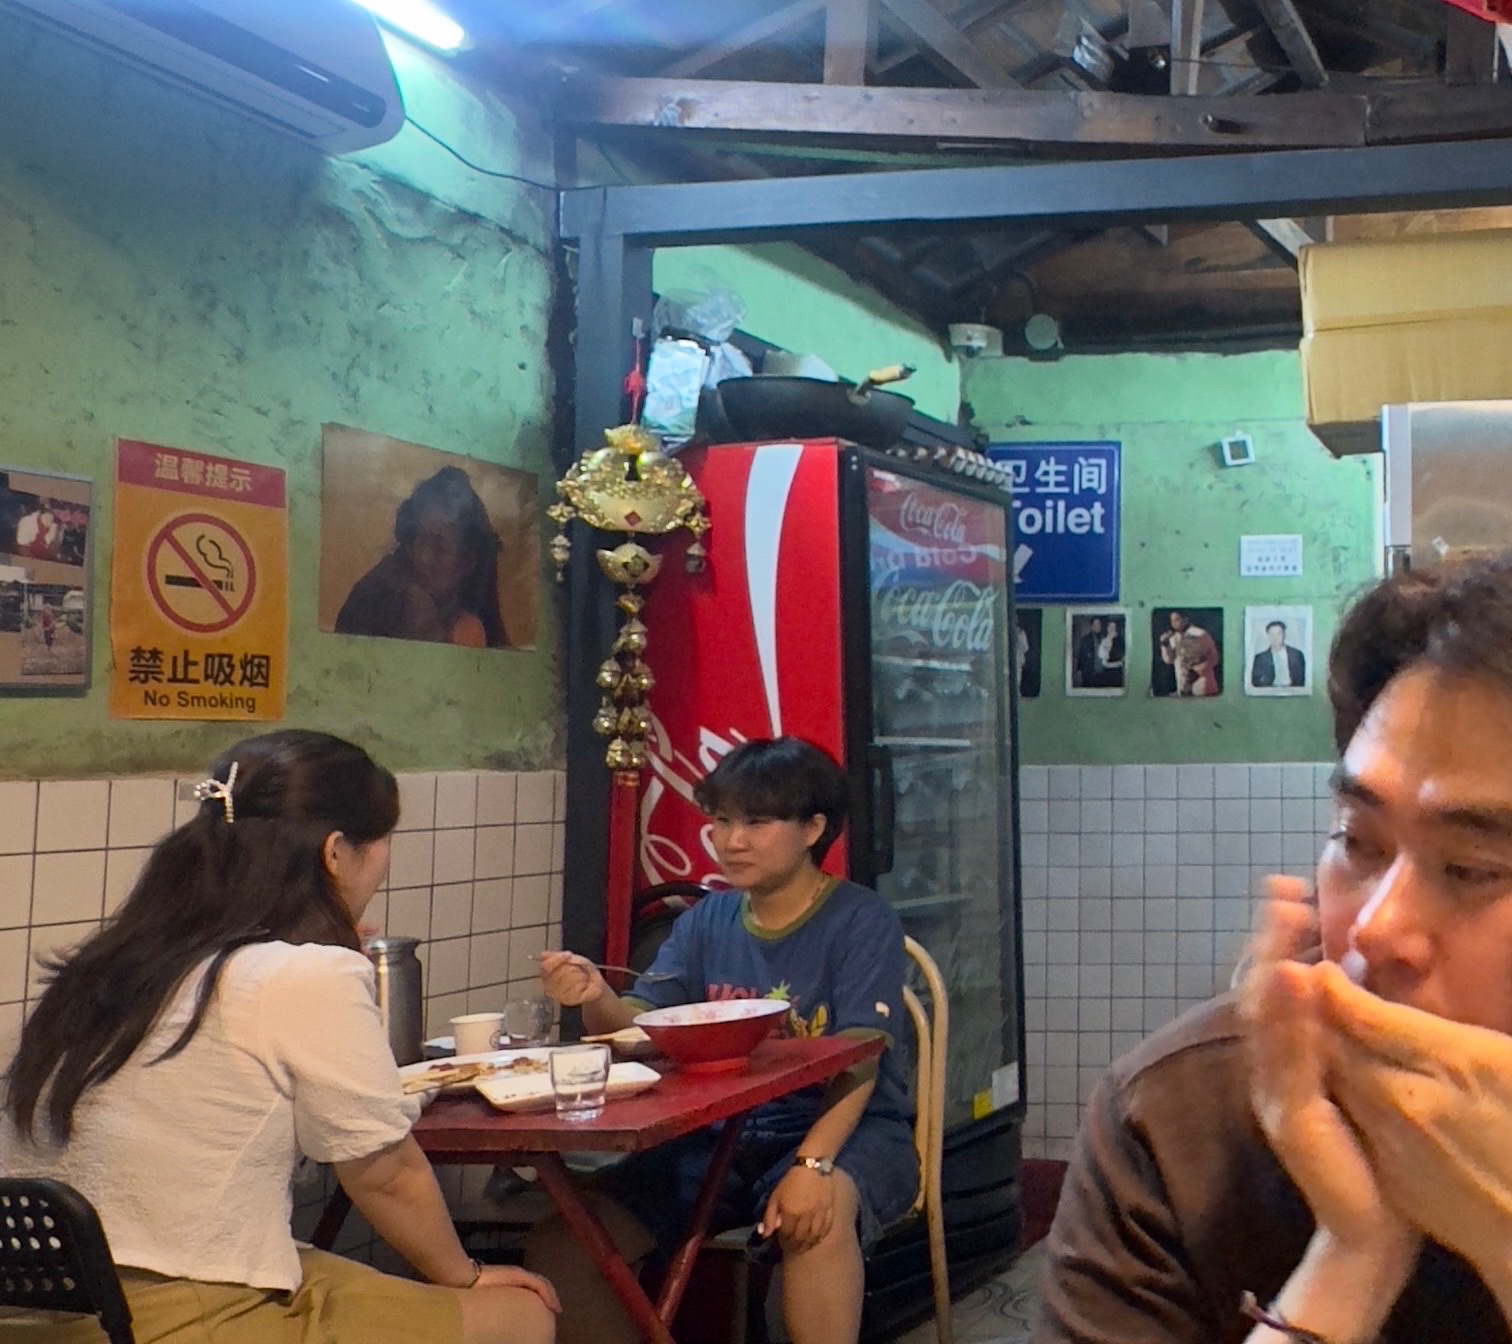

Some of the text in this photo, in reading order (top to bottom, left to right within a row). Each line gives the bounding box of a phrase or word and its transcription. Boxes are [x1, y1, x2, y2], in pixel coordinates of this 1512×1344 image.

[154, 453, 253, 492] 温馨提示
[997, 456, 1107, 495] 卫生间
[1011, 499, 1105, 534] oilet
[128, 646, 270, 688] 禁止吸烟
[143, 690, 256, 713] No Smoking
